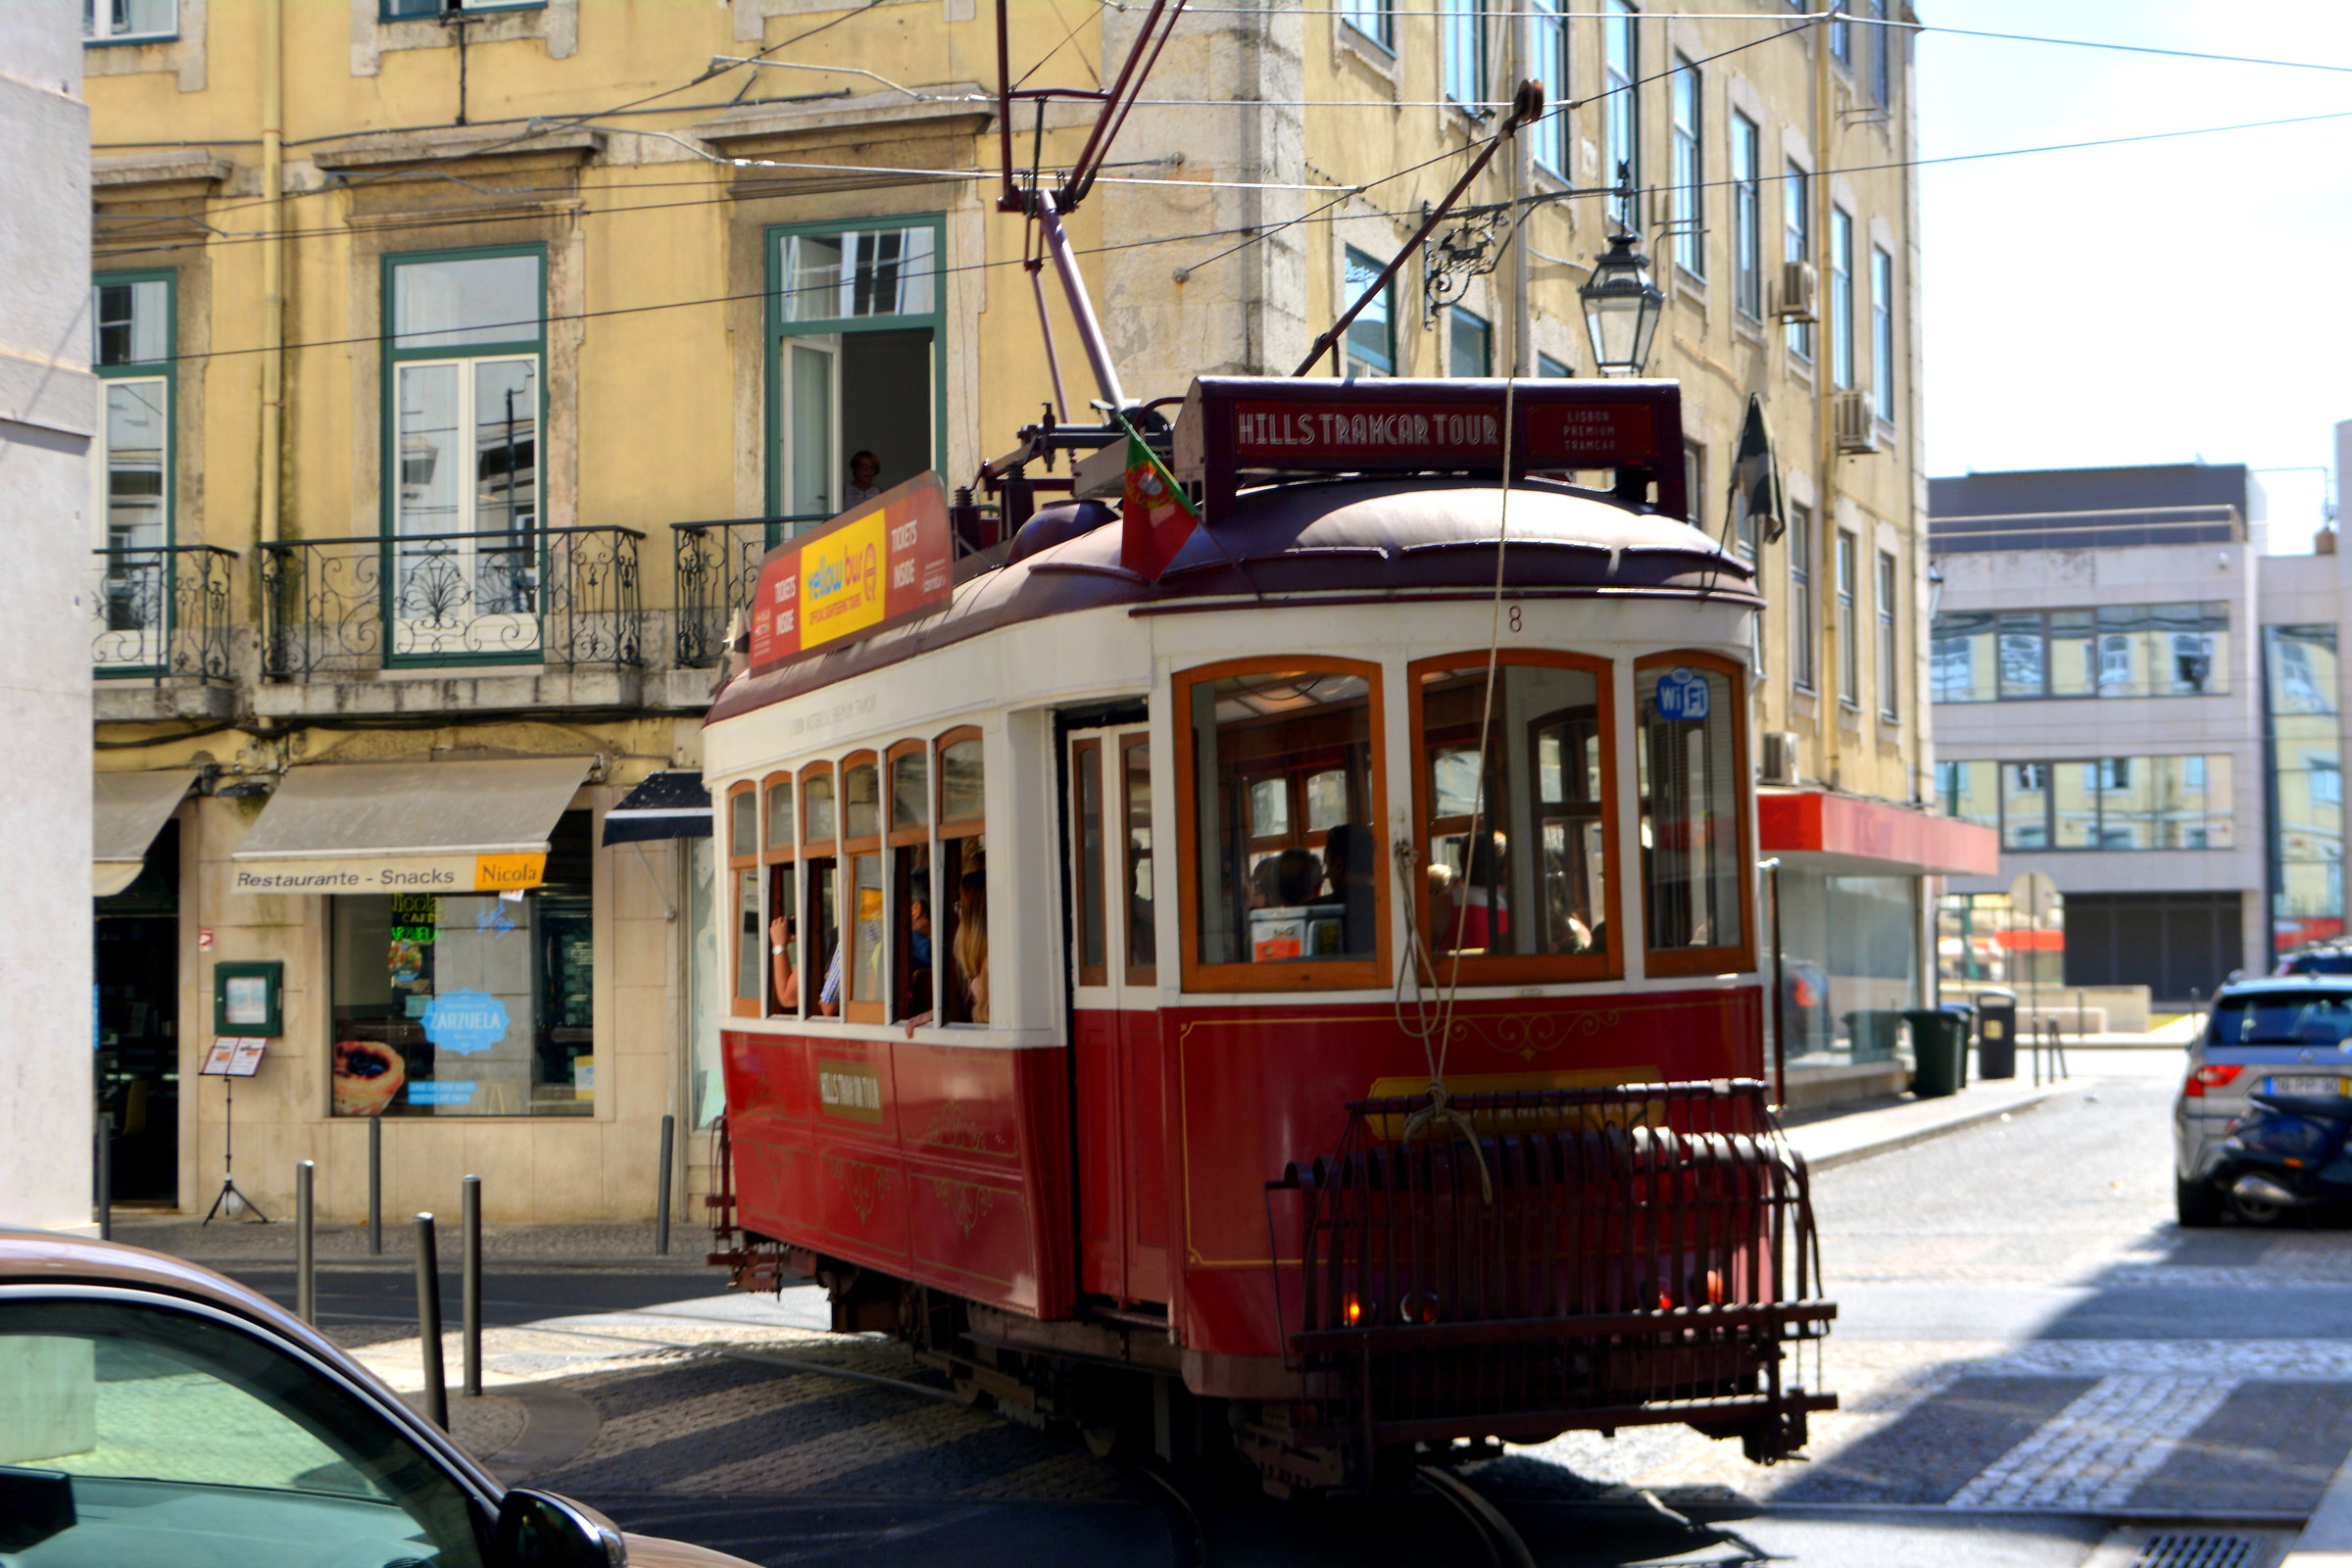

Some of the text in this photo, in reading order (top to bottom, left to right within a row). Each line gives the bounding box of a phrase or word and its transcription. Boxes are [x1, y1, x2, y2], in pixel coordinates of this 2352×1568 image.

[1238, 413, 1498, 446] HILLS TRAMCAR TOUR
[1567, 411, 1610, 422] LISBON
[1563, 425, 1615, 437] PREMIUM
[1564, 439, 1615, 451] TRAMCAR
[892, 519, 917, 553] TICKETS
[808, 555, 844, 603] yellow
[893, 558, 915, 590] INSIDE
[774, 574, 797, 605] TICKETS
[775, 608, 795, 636] INSIDE
[1508, 605, 1522, 633] 8
[236, 871, 360, 887] Restaurante
[380, 868, 455, 885] Snacks
[481, 862, 537, 883] Nicola
[391, 925, 441, 942] ARZUELA
[429, 1011, 502, 1030] ZARZUELA
